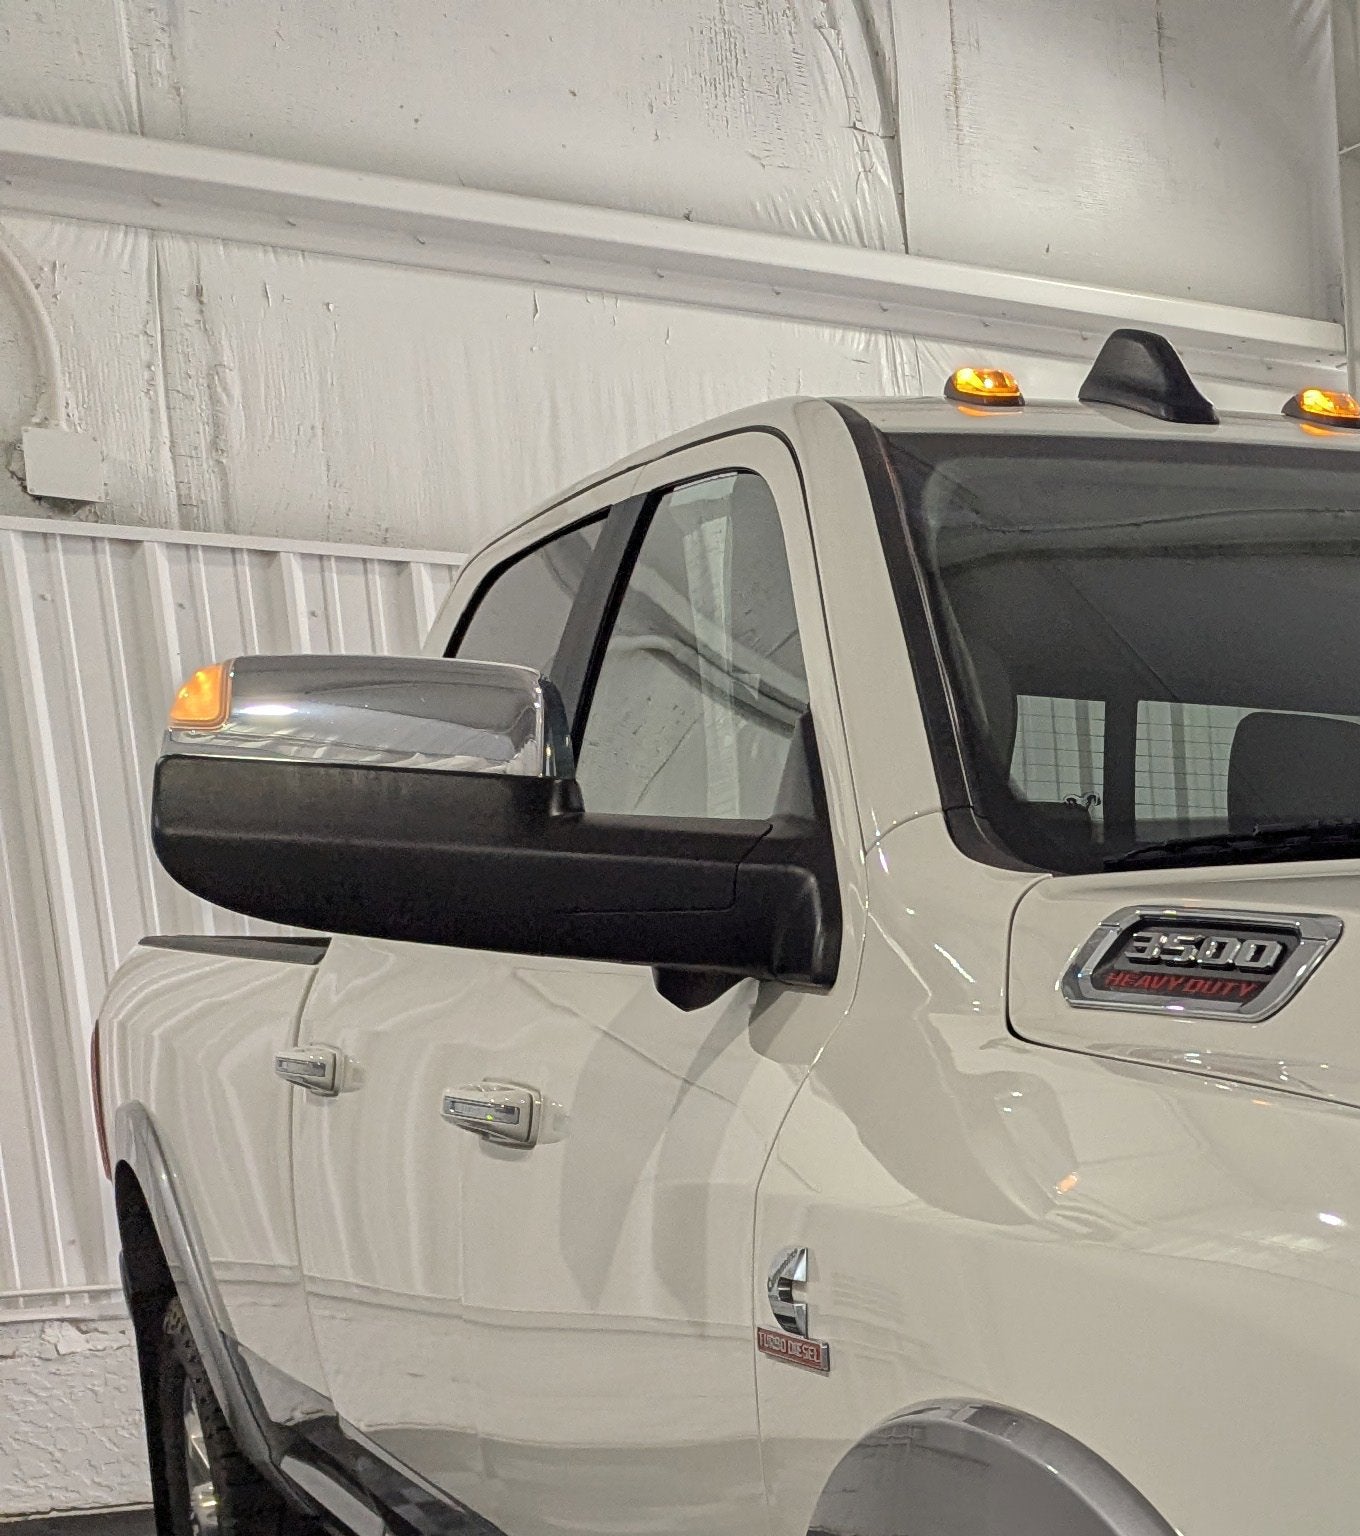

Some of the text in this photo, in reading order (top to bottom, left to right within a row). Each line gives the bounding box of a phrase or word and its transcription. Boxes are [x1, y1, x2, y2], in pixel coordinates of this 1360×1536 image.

[1124, 930, 1284, 971] 3500
[1105, 971, 1258, 997] HEAVY DUTY
[758, 1331, 822, 1363] TURBO DIESEL
